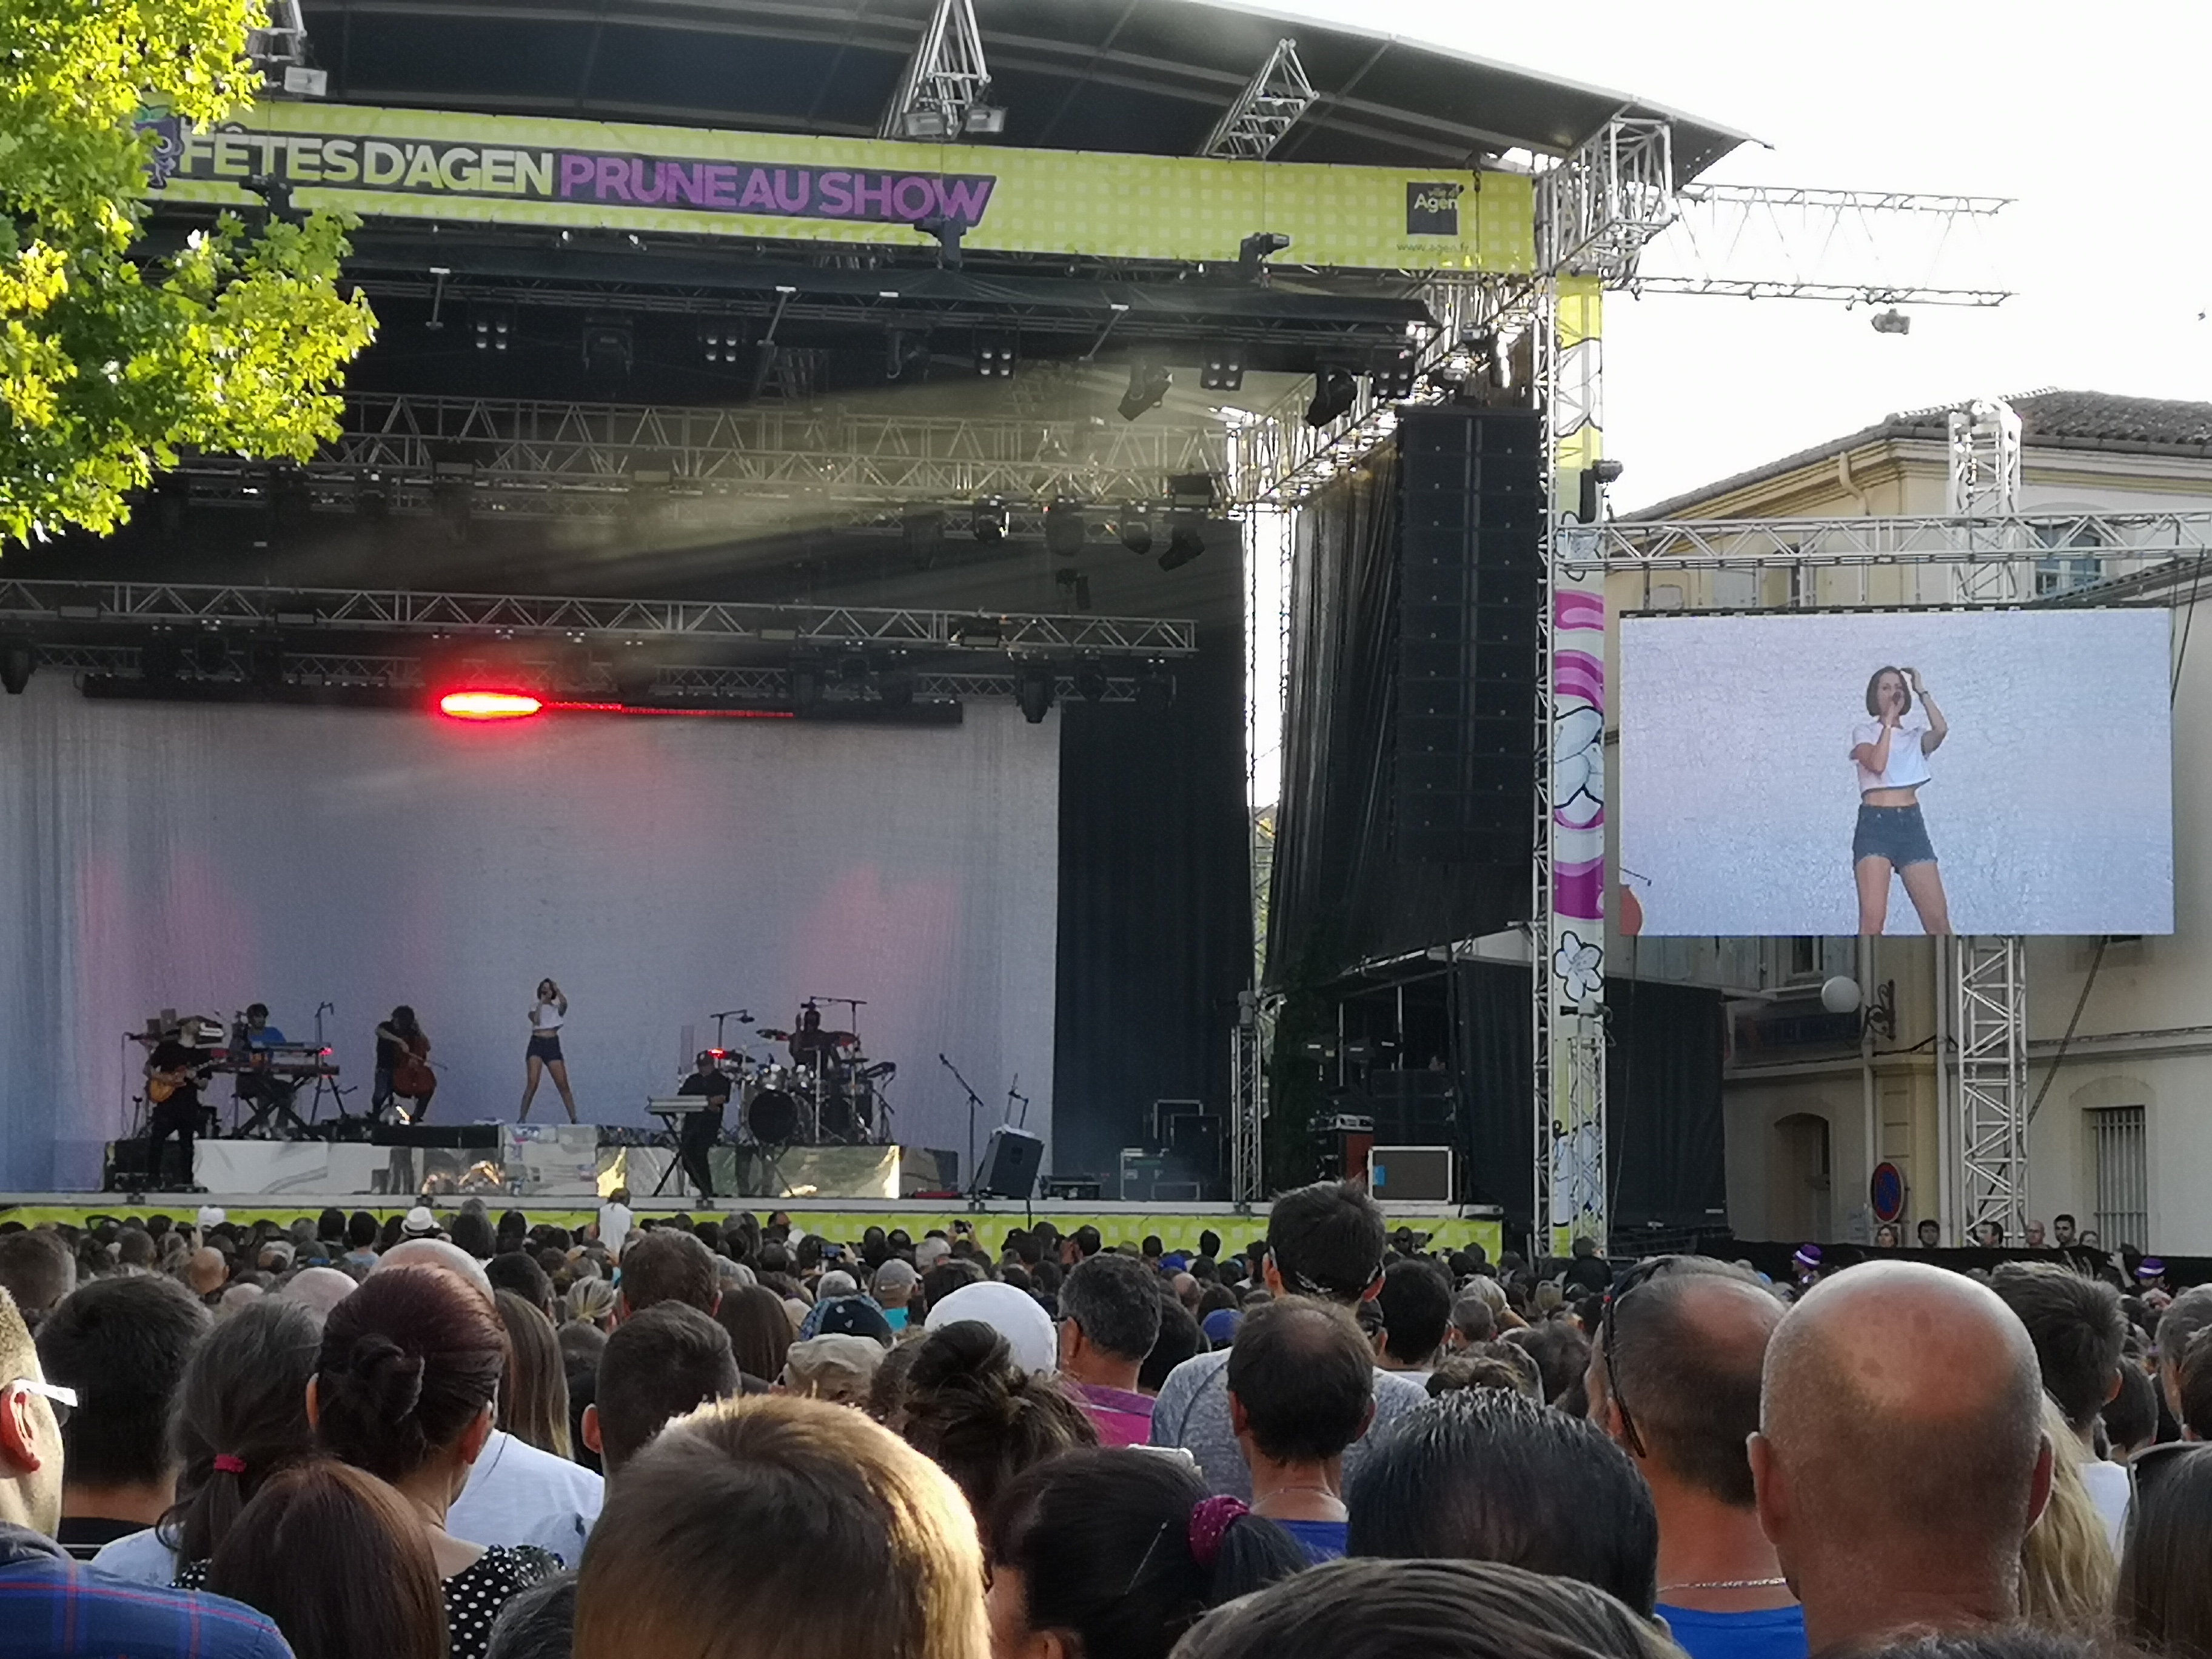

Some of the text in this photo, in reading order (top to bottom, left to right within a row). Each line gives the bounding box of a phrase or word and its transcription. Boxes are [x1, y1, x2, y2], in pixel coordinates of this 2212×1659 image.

[179, 126, 993, 222] FÊTES D'AGEN PRUNEAU SHOW
[1414, 193, 1458, 213] Agen
